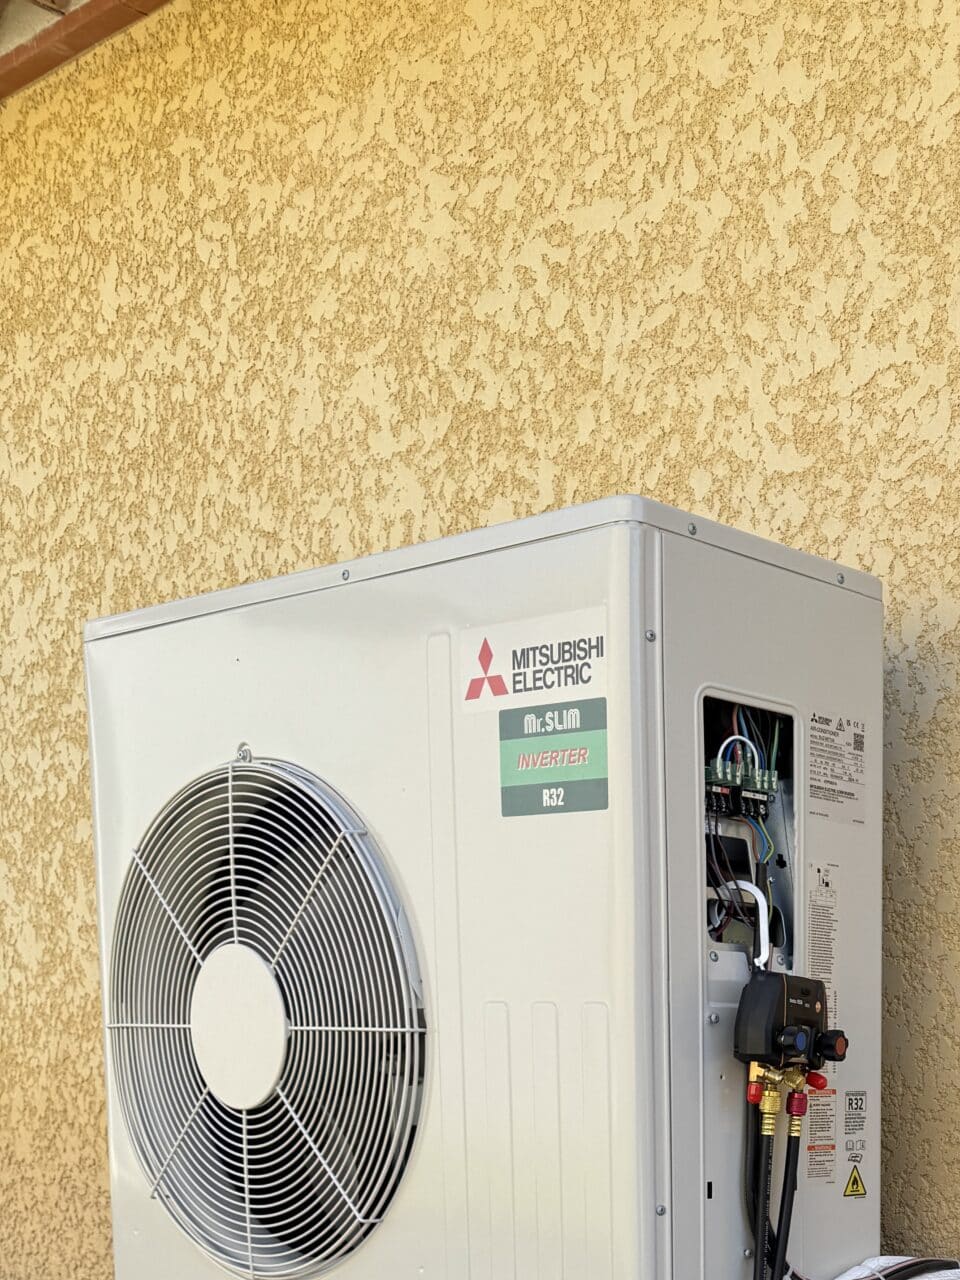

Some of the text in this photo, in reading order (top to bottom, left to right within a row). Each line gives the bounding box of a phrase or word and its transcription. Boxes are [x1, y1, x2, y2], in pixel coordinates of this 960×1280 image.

[512, 636, 604, 670] MITSUBISHI
[512, 662, 592, 693] ELECTRIC
[517, 748, 589, 770] INVERTER
[542, 788, 565, 807] R32
[848, 1097, 864, 1111] R32
